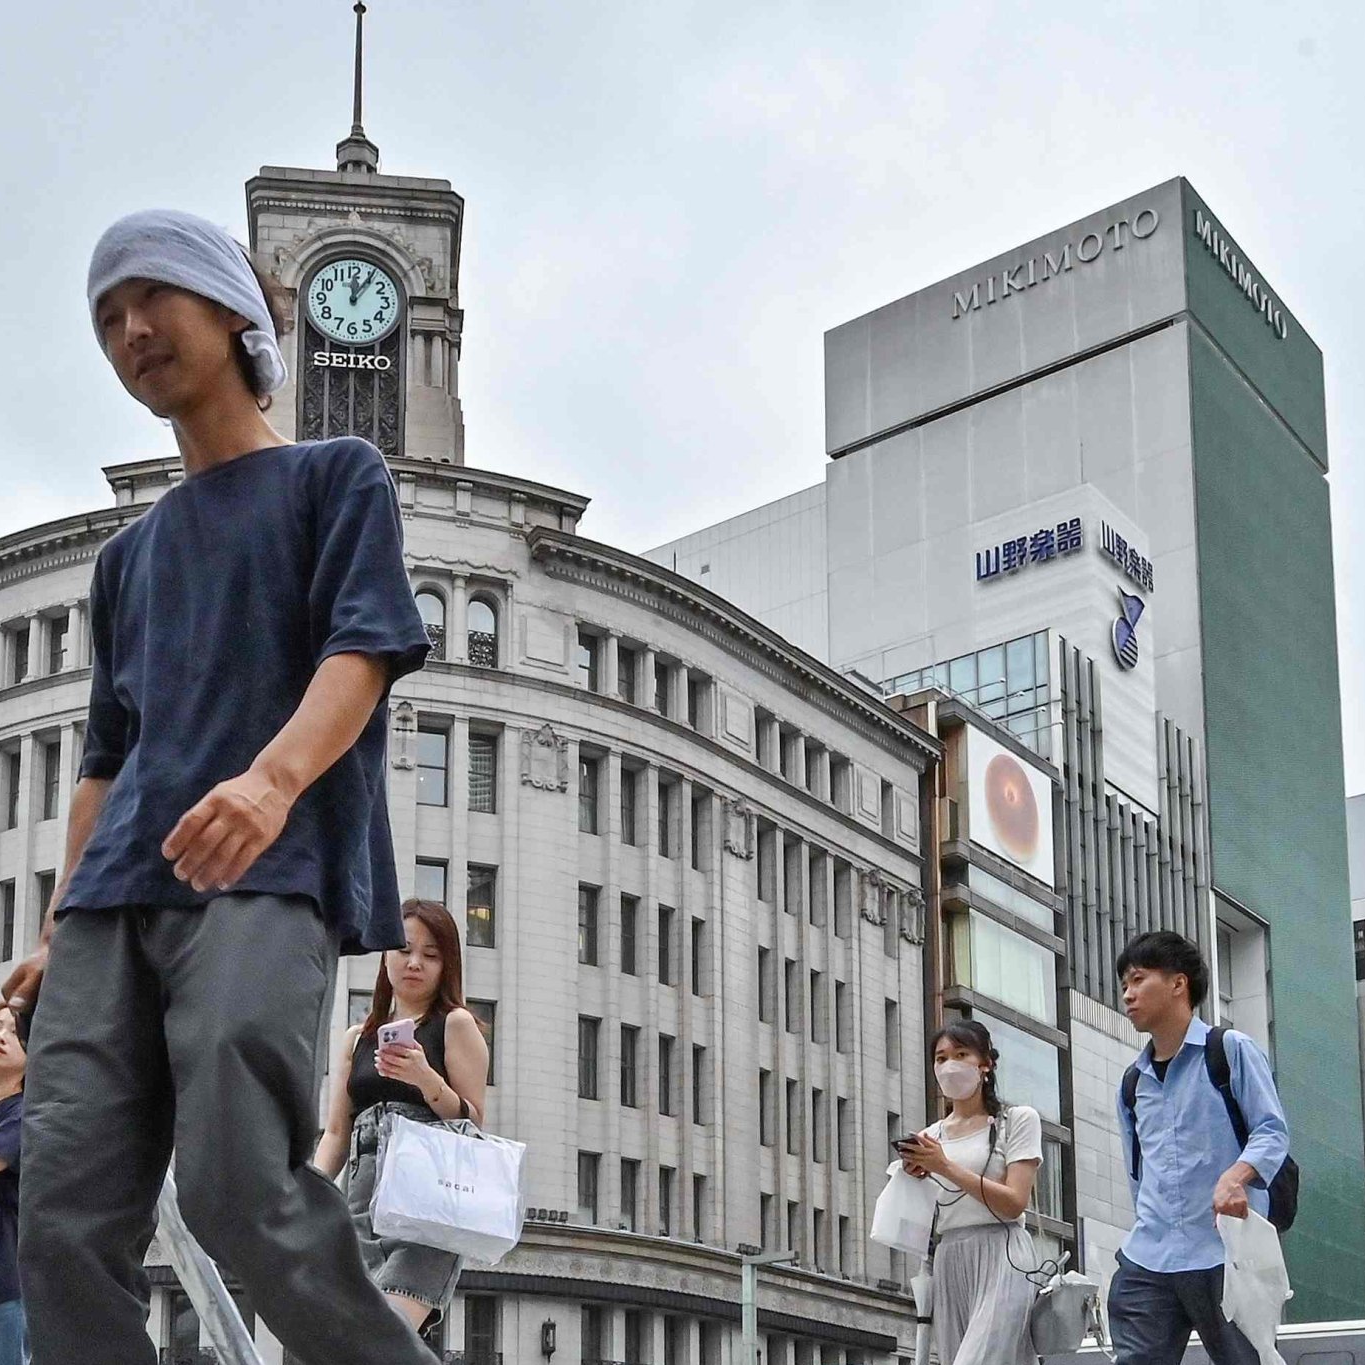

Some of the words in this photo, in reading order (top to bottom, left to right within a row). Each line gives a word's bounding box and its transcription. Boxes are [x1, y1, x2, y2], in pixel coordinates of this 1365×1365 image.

[952, 208, 1159, 320] MIKIMOTO
[334, 268, 344, 281] 11
[348, 266, 361, 279] 12
[1195, 210, 1287, 339] MIKIMOTO
[321, 278, 334, 291] 10
[376, 282, 385, 295] 2
[316, 292, 327, 305] 9
[380, 297, 390, 310] 3
[321, 306, 332, 319] 8
[374, 310, 385, 323] 4
[334, 317, 345, 330] 7
[347, 322, 357, 335] 6
[362, 319, 372, 333] 5
[314, 351, 391, 370] SEIKO
[976, 517, 1082, 581] 山野楽器
[1101, 519, 1154, 594] 山野楽器
